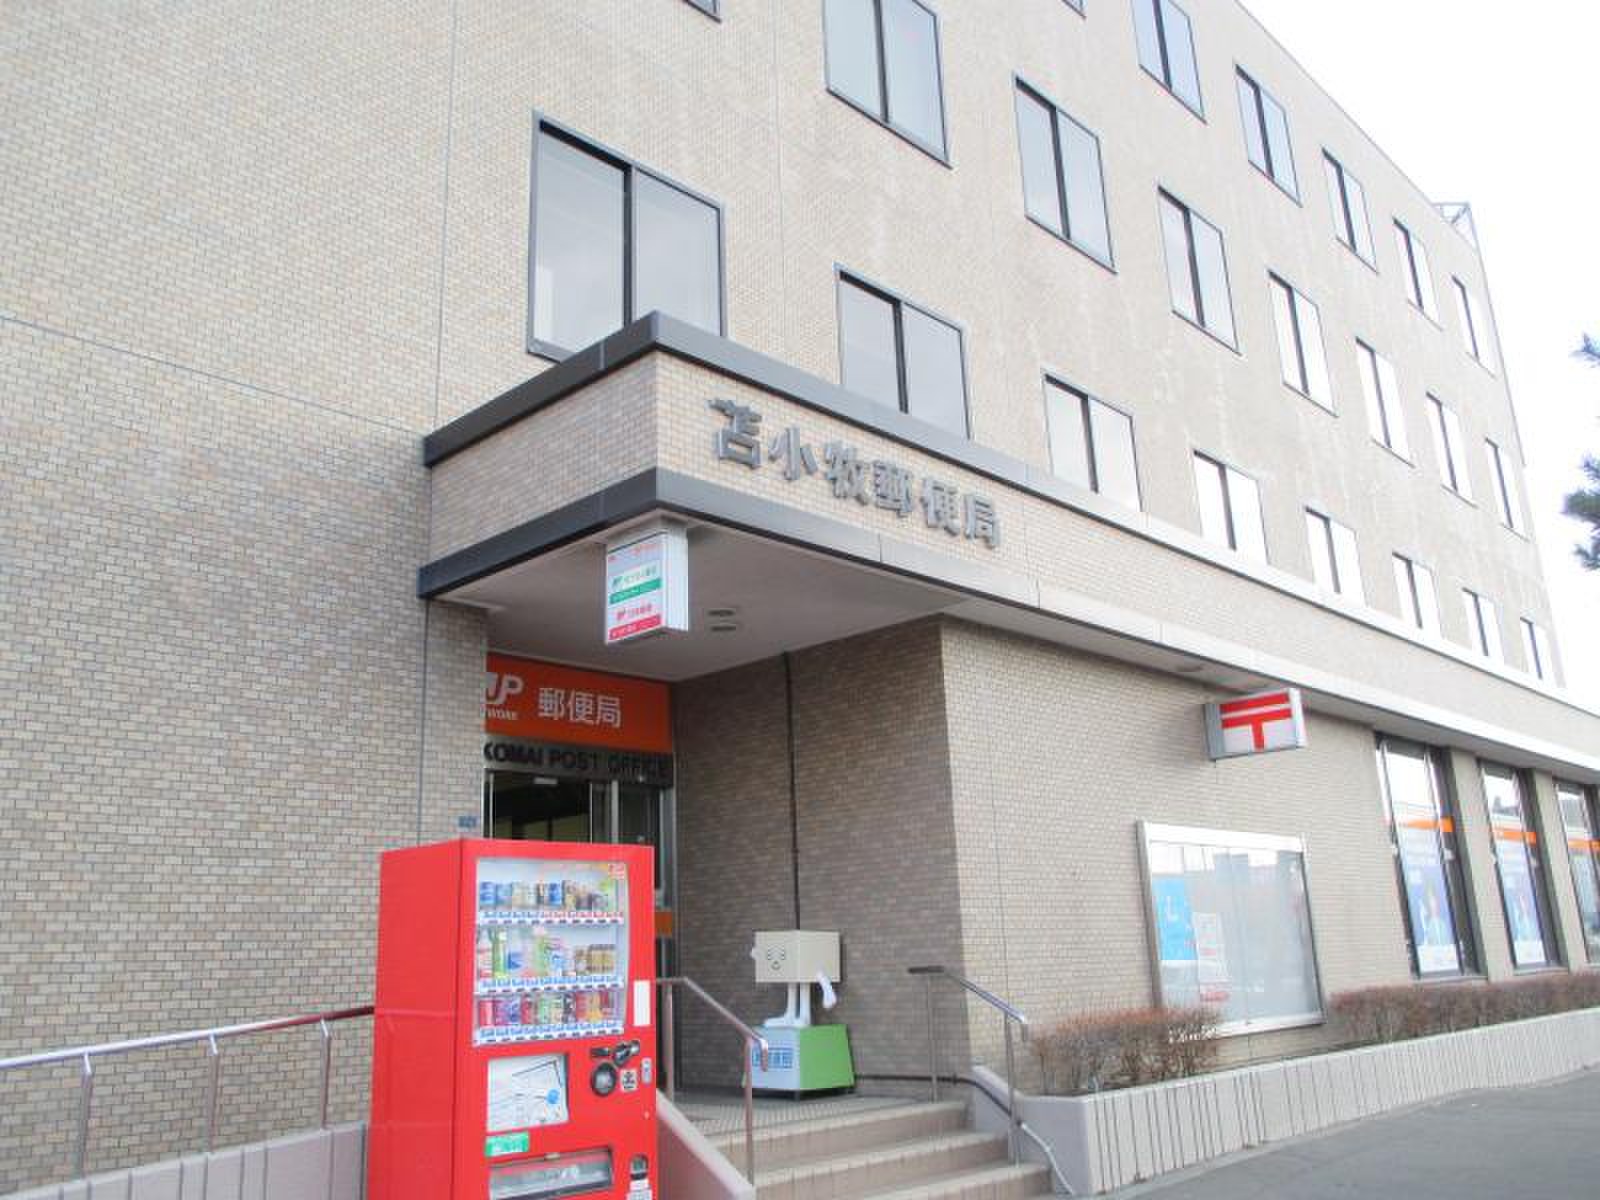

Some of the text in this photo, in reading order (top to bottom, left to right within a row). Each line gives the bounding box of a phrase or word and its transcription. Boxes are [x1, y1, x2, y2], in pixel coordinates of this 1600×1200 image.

[709, 399, 998, 548] 苫小牧郵便局
[538, 687, 622, 729] 郵便局
[549, 750, 600, 771] POST
